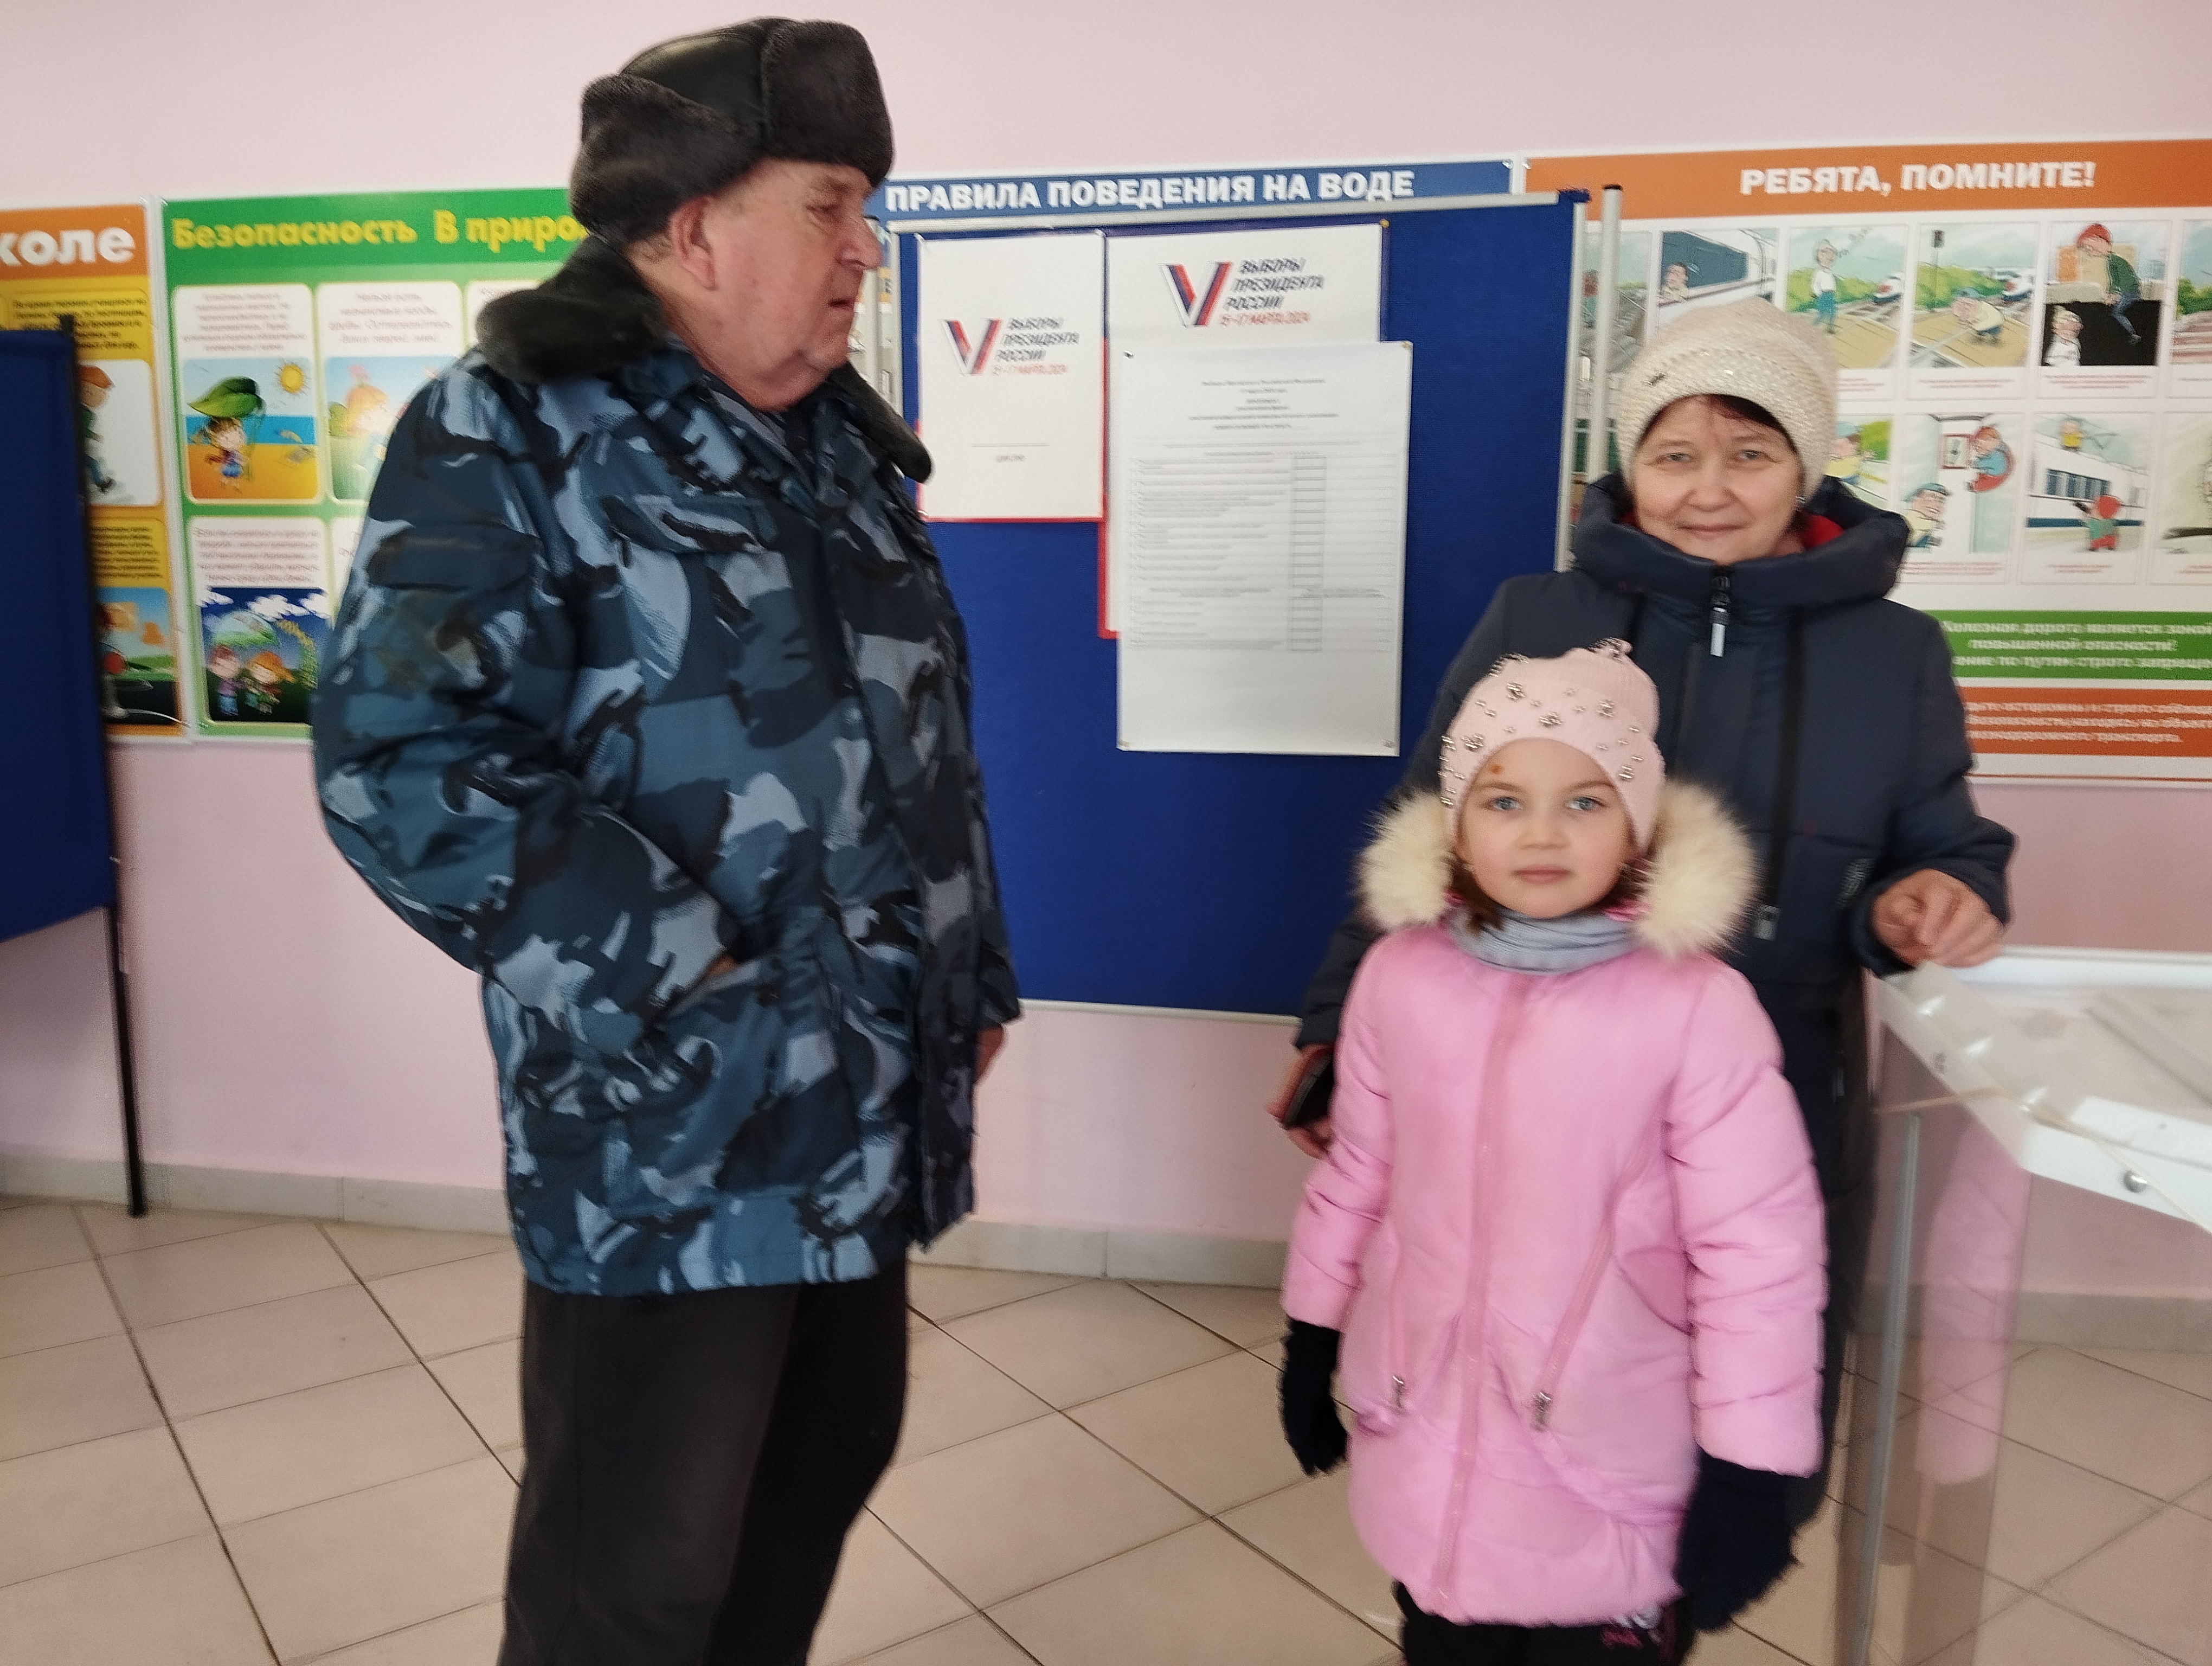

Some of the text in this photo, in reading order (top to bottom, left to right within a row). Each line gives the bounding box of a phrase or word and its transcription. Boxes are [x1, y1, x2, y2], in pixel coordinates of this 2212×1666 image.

[885, 170, 1414, 212] ПРАВИЛА ПОВЕДЕНИЯ НА ВОДЕ
[1740, 161, 2096, 197] РЕБЯТА, ПОМНИТЕ!
[172, 209, 590, 253] Безопасность В приро
